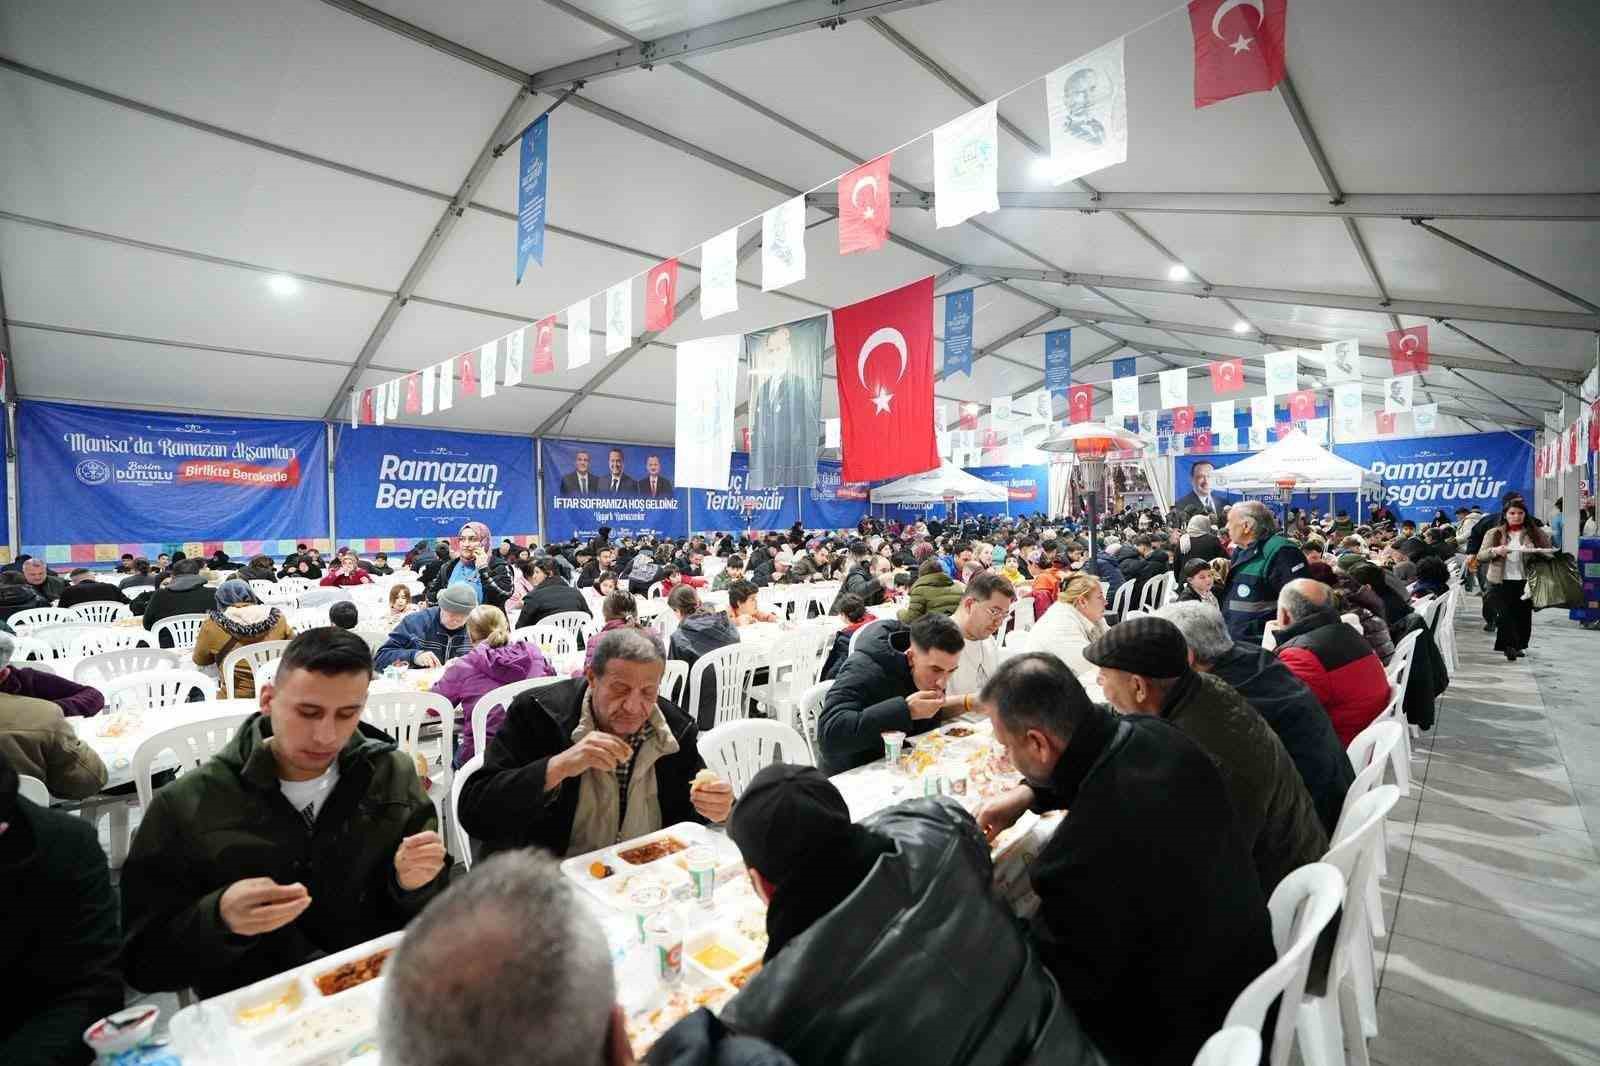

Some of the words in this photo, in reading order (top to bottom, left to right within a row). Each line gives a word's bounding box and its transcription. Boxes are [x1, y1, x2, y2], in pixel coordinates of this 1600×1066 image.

[64, 433, 154, 455] Manisa'da
[158, 437, 228, 457] Ramazan
[116, 470, 174, 481] DUTLULU
[185, 464, 231, 478] Birlikte
[232, 468, 289, 482] Bereketle
[379, 454, 499, 483] Ramazan
[375, 482, 504, 510] Berekettir
[553, 496, 580, 509] İFTAR
[580, 498, 628, 510] SOFRAMIZA
[629, 498, 646, 512] HOŞ
